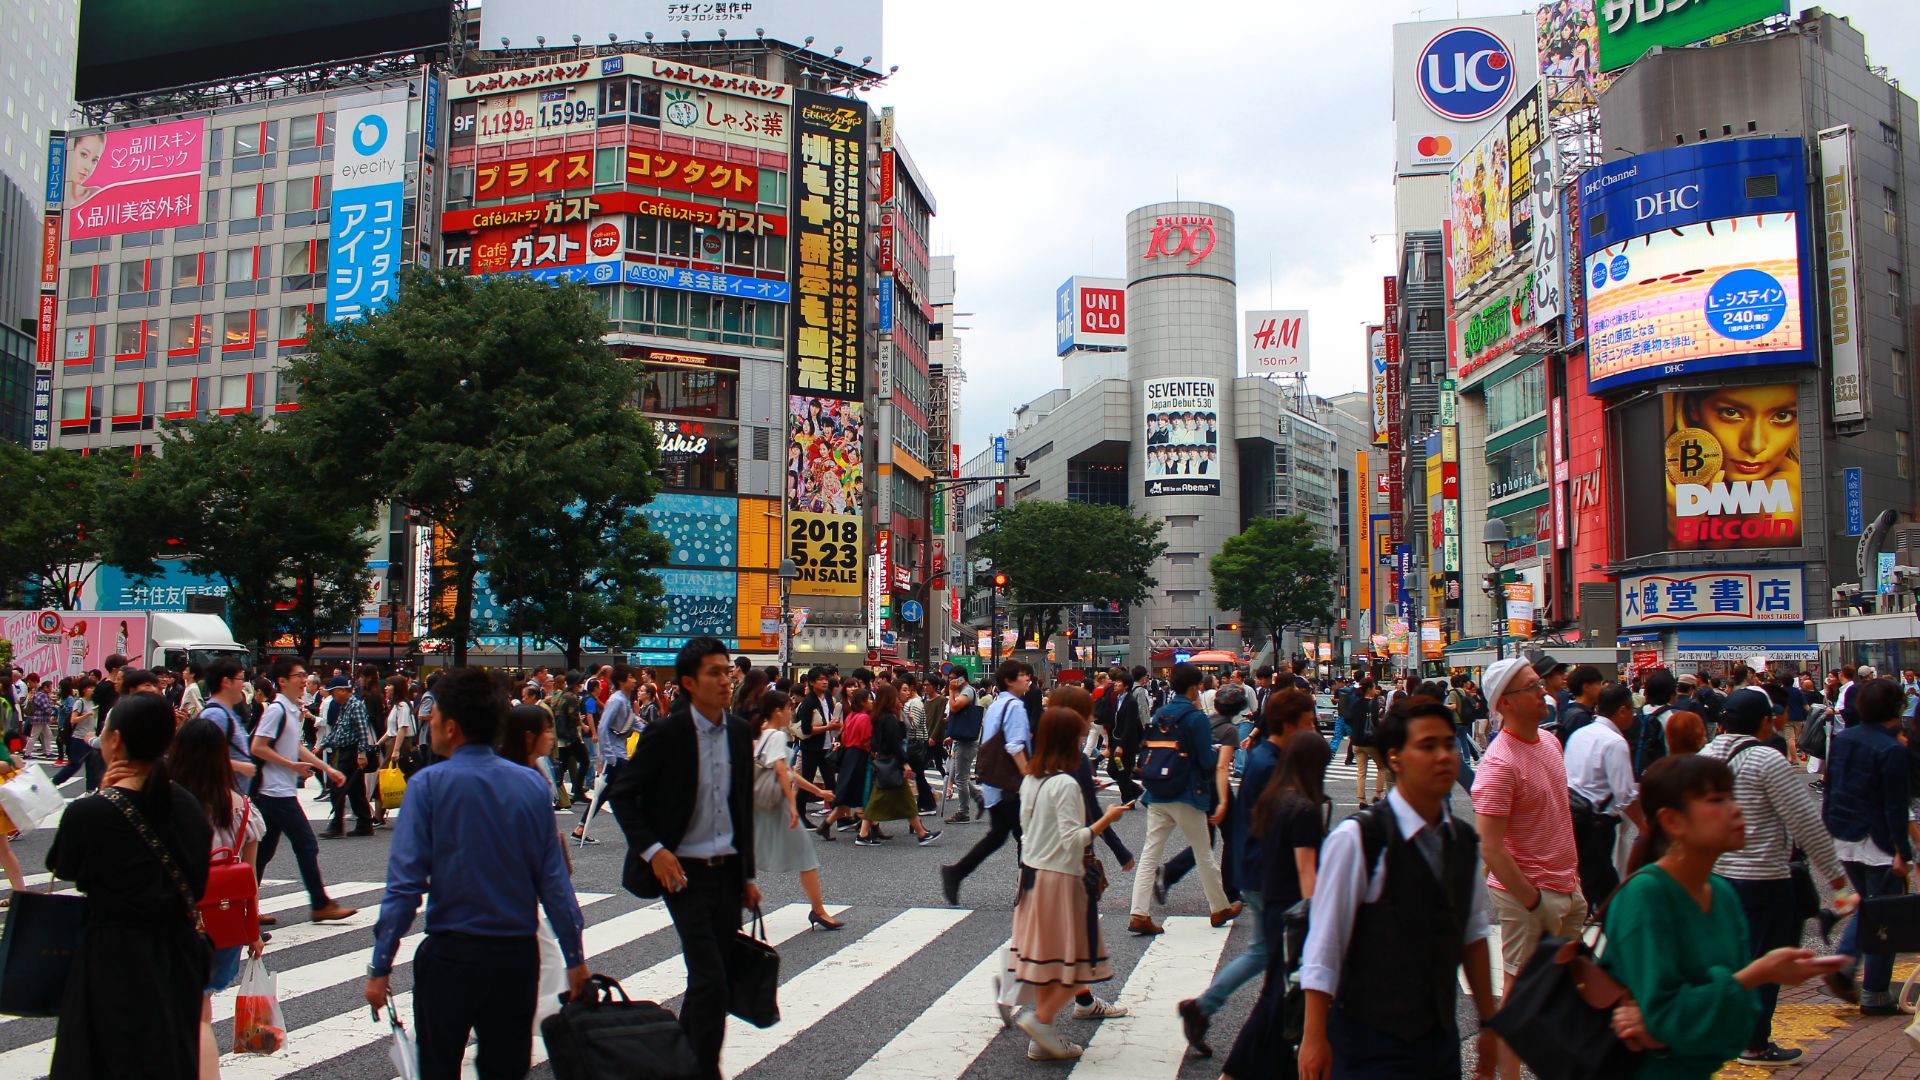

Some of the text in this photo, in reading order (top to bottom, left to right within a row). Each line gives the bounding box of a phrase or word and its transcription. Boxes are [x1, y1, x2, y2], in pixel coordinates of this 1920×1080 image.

[668, 2, 752, 14] デザイン製作中
[466, 62, 590, 93] しゃぶしゃぶバイキング
[652, 60, 786, 99] しゃぶしゃぶバイキング
[453, 114, 475, 132] 9F
[707, 101, 783, 137] しゃぶ葉
[129, 131, 197, 155] 品川スキン
[50, 148, 61, 198] 東急リバブル
[128, 150, 188, 174] クリニック
[342, 158, 396, 180] eyecity
[478, 155, 590, 192] プライス
[628, 151, 753, 192] コンタクト
[1585, 167, 1637, 195] DHC Channel
[87, 194, 192, 228] 品川美容外科
[545, 198, 600, 224] ガスト
[1635, 185, 1700, 221] DHC
[717, 209, 774, 236] ガスト
[1156, 216, 1214, 226] SHIBUYA
[1533, 147, 1558, 313] もんじゃ
[478, 243, 508, 259] Café
[510, 233, 580, 269] ガスト
[593, 237, 617, 248] ガスト
[1143, 224, 1217, 267] 109
[1825, 165, 1850, 346] Taisei neon
[371, 200, 393, 315] コンタク
[446, 247, 472, 267] 7F
[831, 138, 846, 392] MOMOIRO CLOVER Z BEST ALBUM
[596, 266, 613, 280] 6F
[630, 265, 787, 298] AEON 英会話イーオン
[1085, 293, 1117, 310] UNI
[1085, 312, 1120, 330] QLO
[1723, 310, 1770, 325] 240mg
[1253, 317, 1302, 350] H&M
[881, 345, 889, 394] 渋谷駅前ビル
[1664, 364, 1684, 373] DHC
[952, 364, 960, 410] CMERA
[1148, 382, 1215, 399] SEVENTEEN
[34, 379, 50, 437] 加藤眼科
[1151, 398, 1212, 410] Japan Debut 5.30
[34, 441, 46, 449] 5F
[1490, 471, 1532, 498] Euphoria
[1675, 479, 1793, 517] DMM
[791, 519, 857, 543] 2018
[1676, 514, 1793, 542] Bitcoin
[791, 543, 857, 568] 5.23
[792, 568, 857, 583] ON SALE
[1625, 579, 1791, 616] 大盛堂書店
[26, 631, 38, 649] AR
